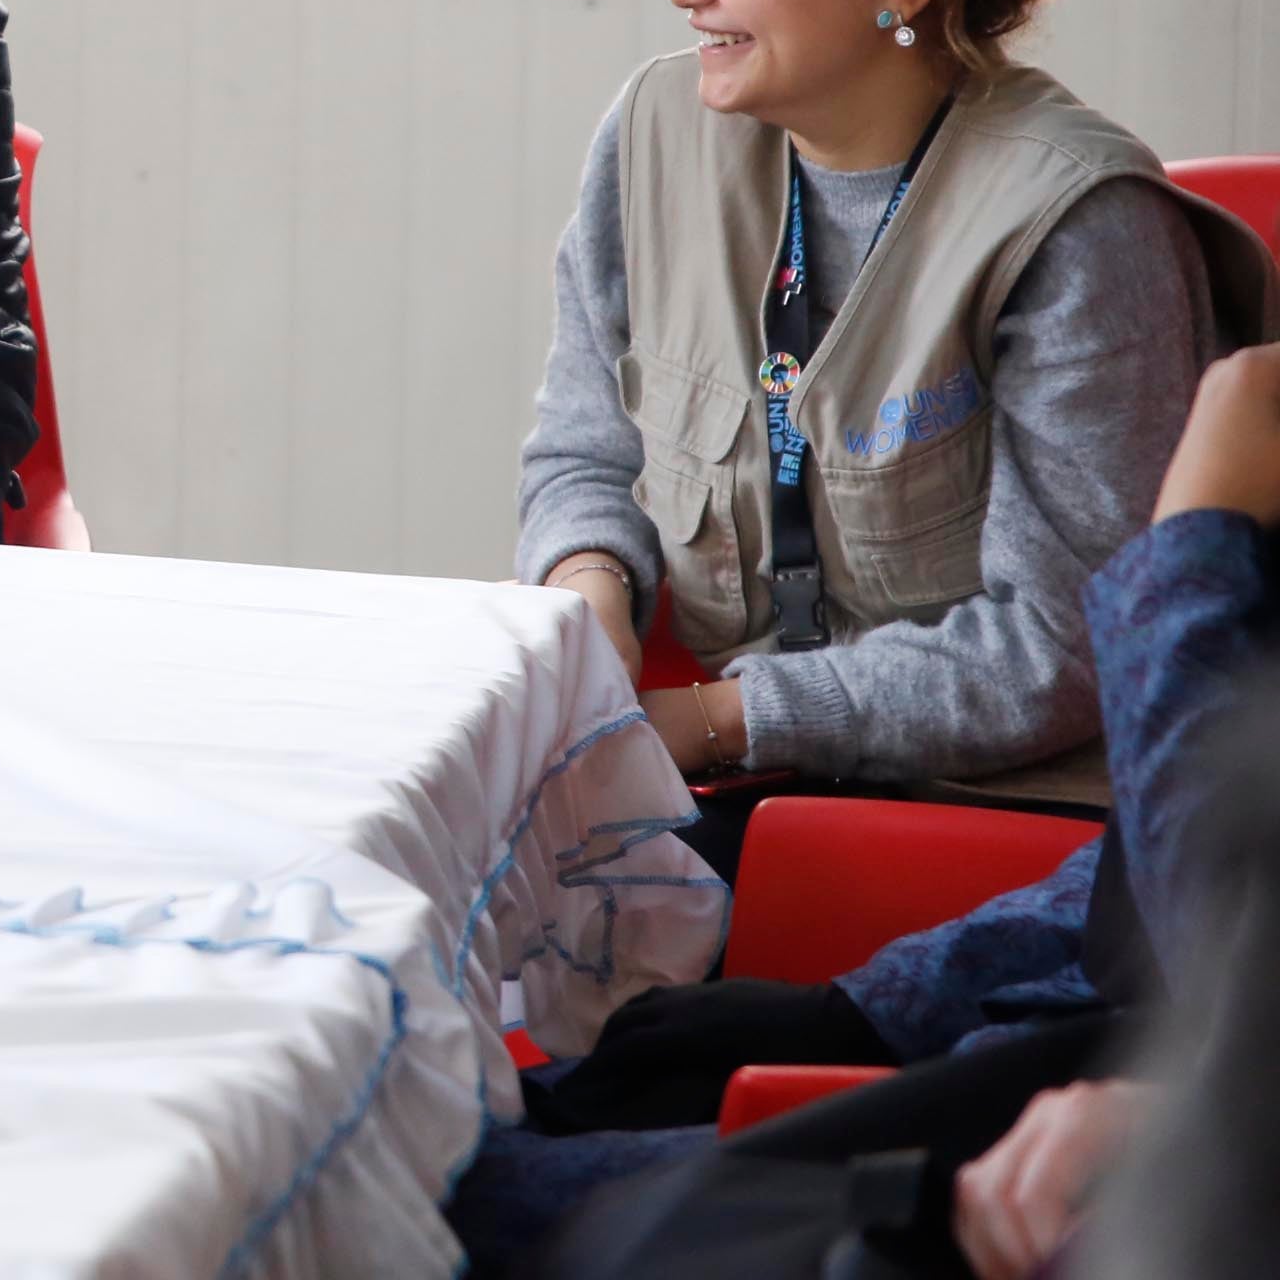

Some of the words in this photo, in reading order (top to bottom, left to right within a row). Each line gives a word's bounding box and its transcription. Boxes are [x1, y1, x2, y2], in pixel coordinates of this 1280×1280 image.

[768, 402, 784, 433] UN
[903, 390, 946, 418] UN
[845, 412, 953, 456] WOMEN
